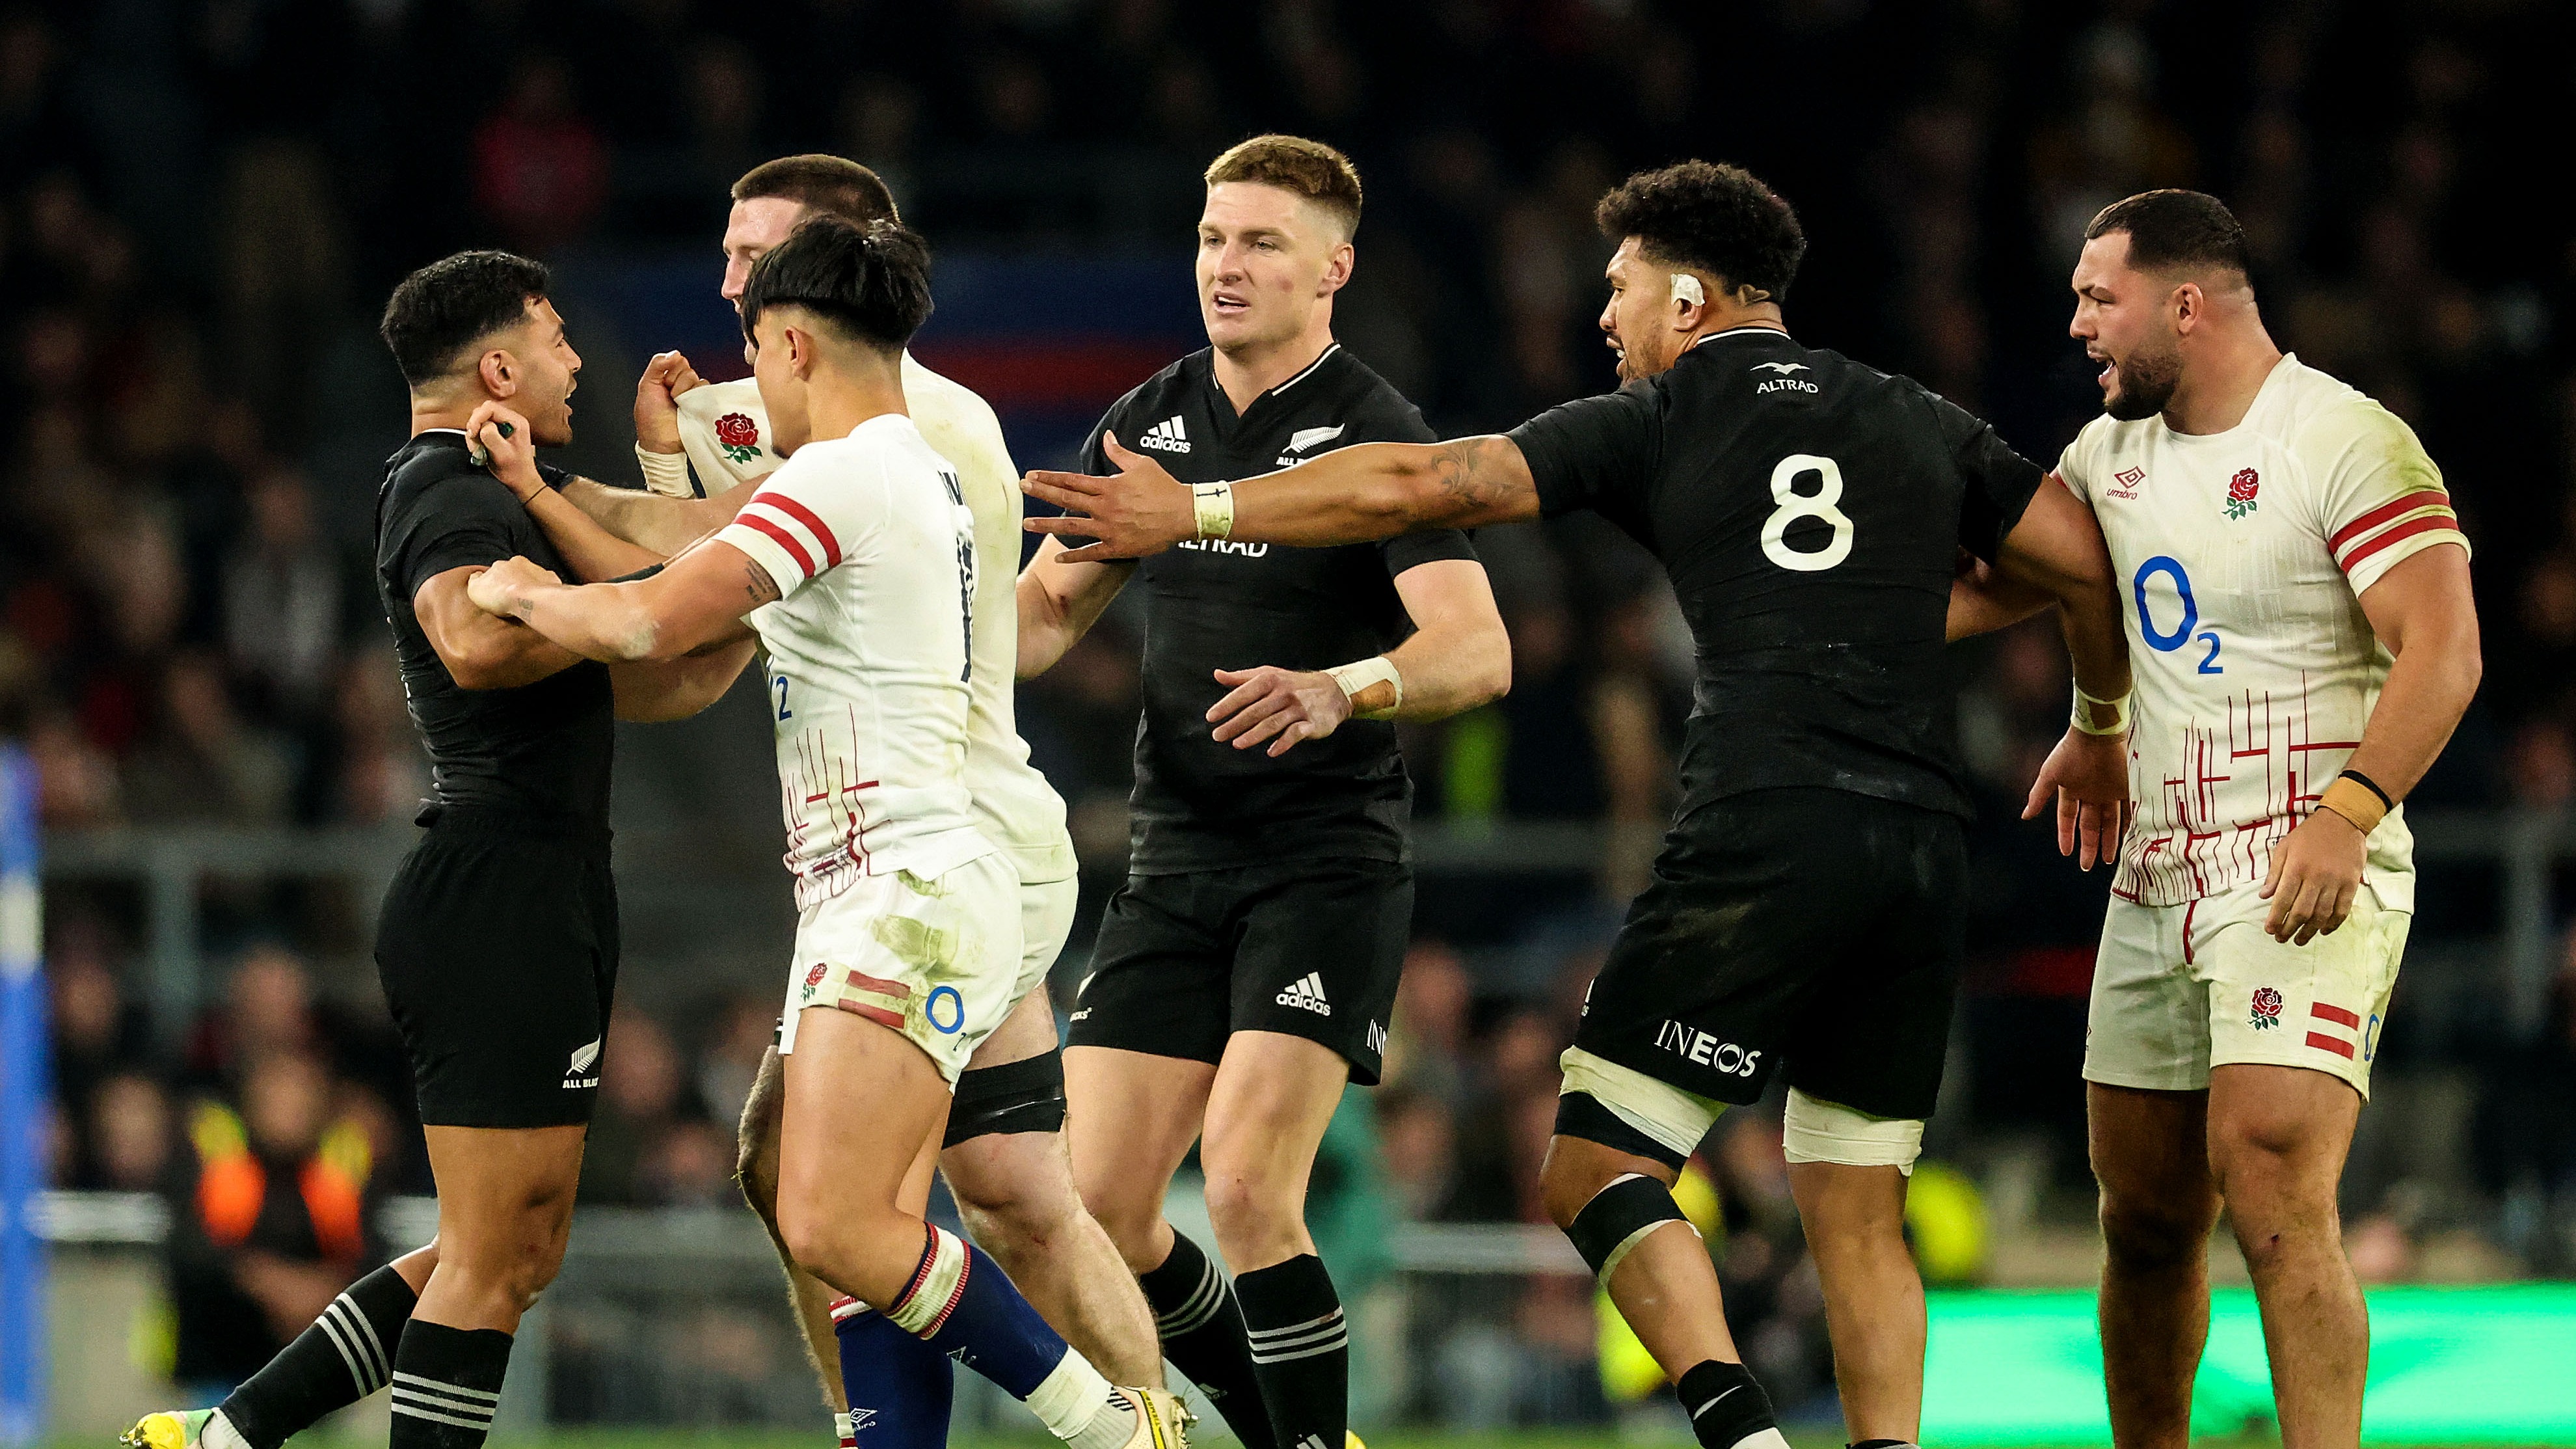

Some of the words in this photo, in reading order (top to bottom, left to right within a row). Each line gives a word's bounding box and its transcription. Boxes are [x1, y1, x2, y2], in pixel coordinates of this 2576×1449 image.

[1756, 379, 1819, 394] ALTRAD
[1140, 435, 1191, 454] adidas
[1276, 456, 1295, 466] ALL
[2106, 488, 2138, 500] umbro
[1760, 454, 1854, 571] 8
[1276, 992, 1331, 1017] adidas
[1654, 1019, 1762, 1077] INEOS
[562, 1079, 582, 1089] ALL
